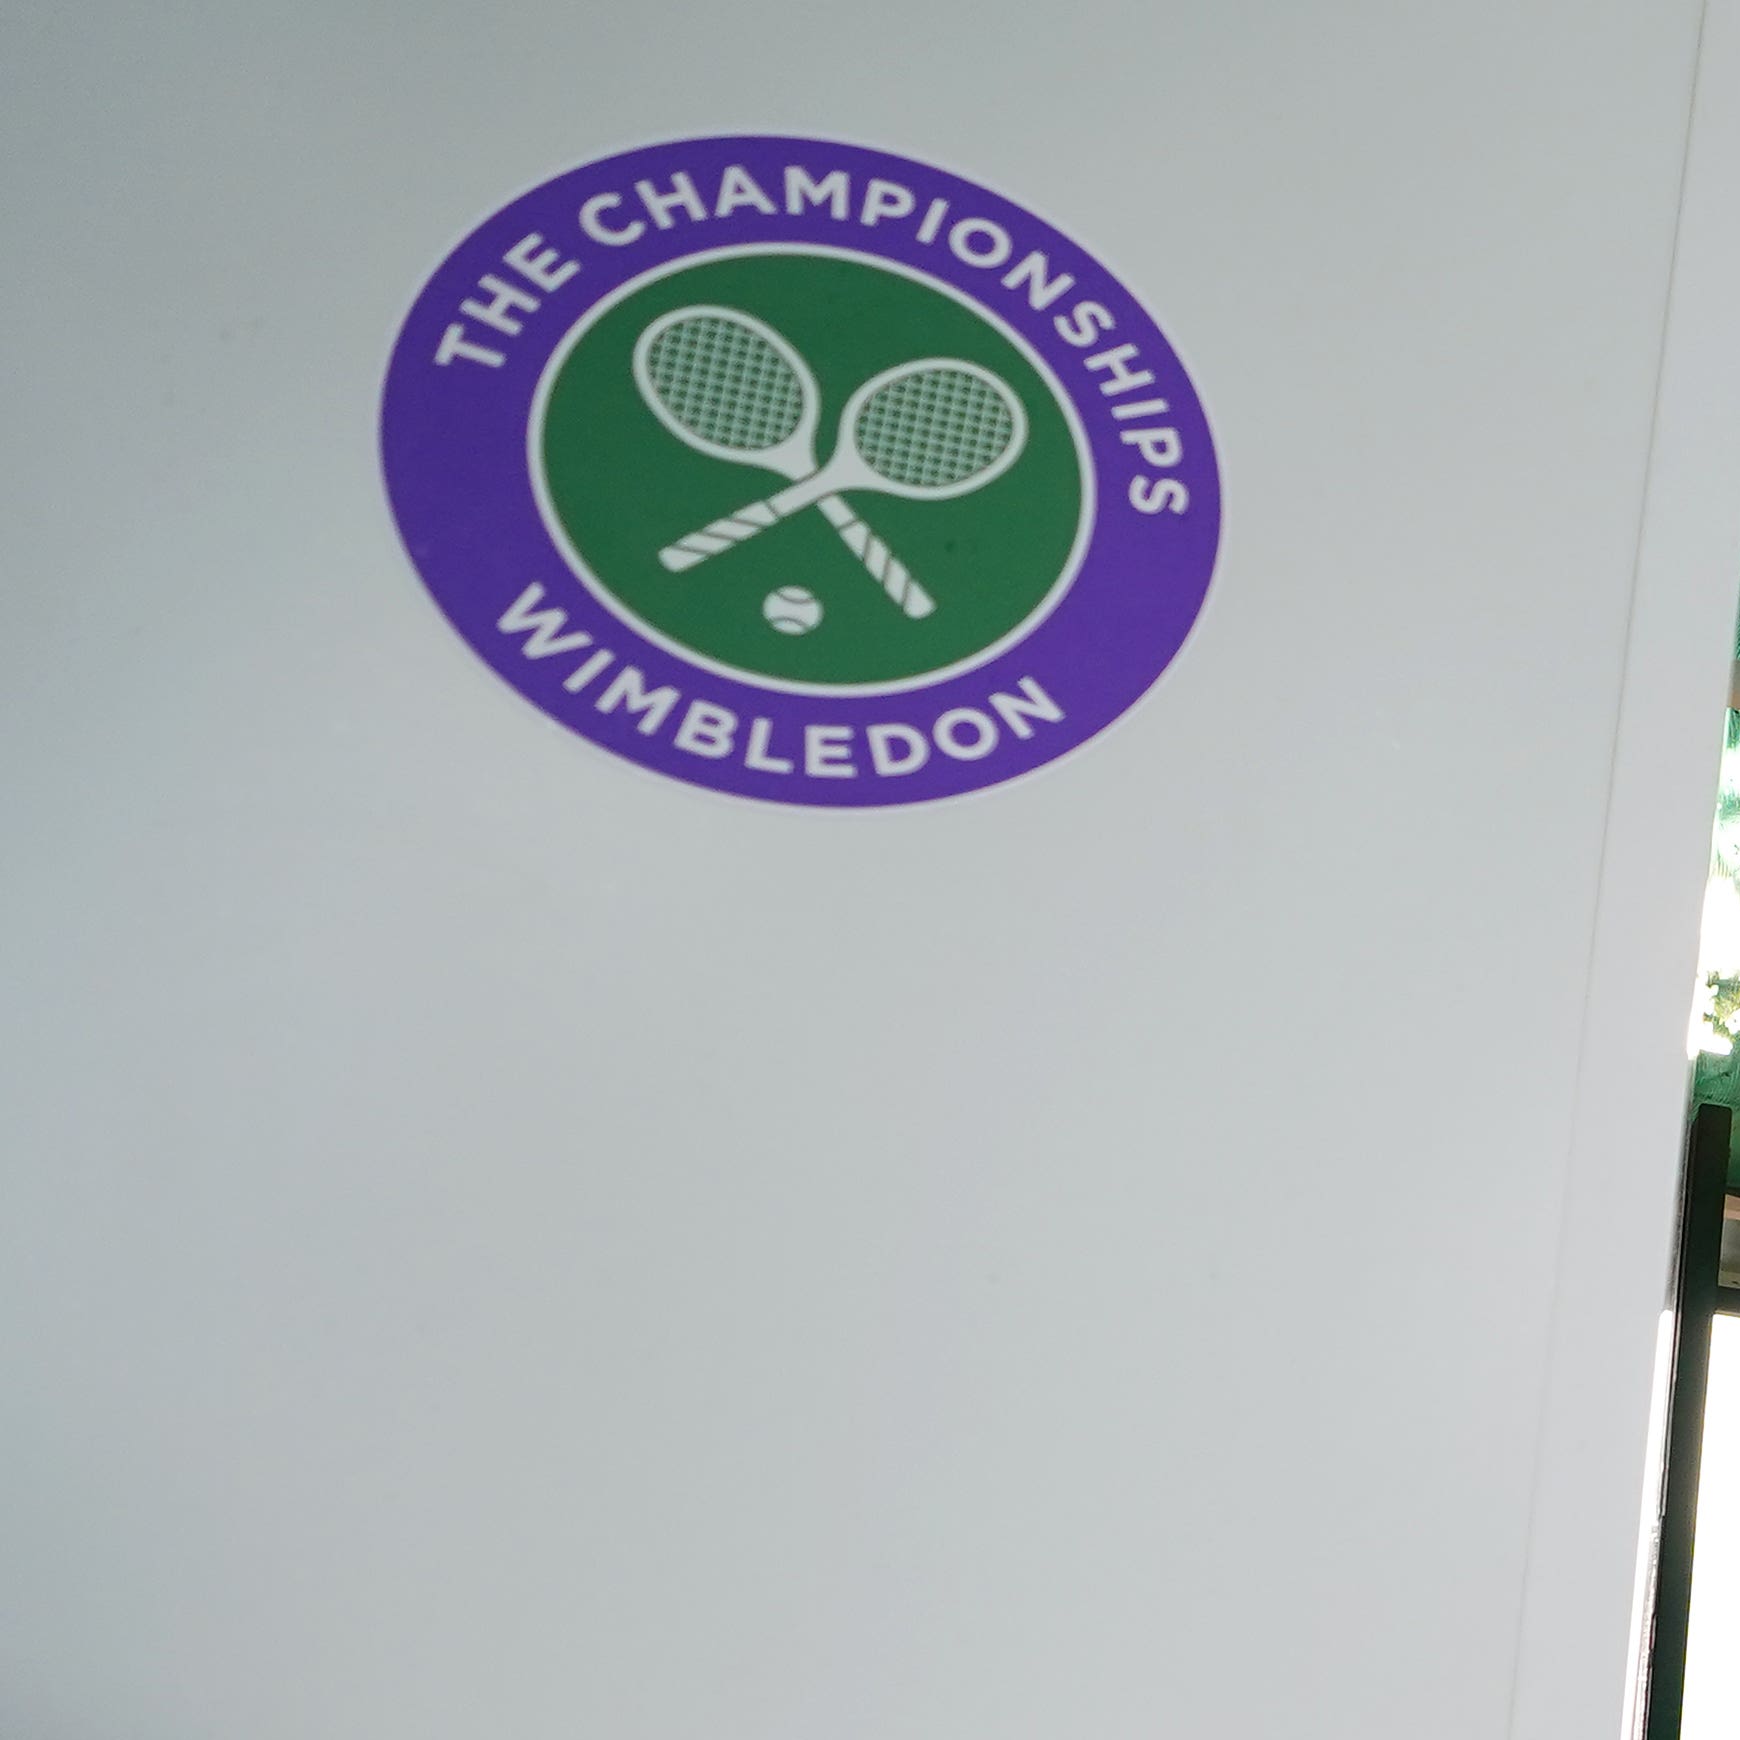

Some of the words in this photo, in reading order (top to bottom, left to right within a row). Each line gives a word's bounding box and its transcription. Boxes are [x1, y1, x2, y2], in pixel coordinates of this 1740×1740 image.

[435, 231, 581, 371] THE
[577, 165, 1190, 517] CHAMPIONSHIPS
[497, 582, 1066, 779] WIMBLEDON
